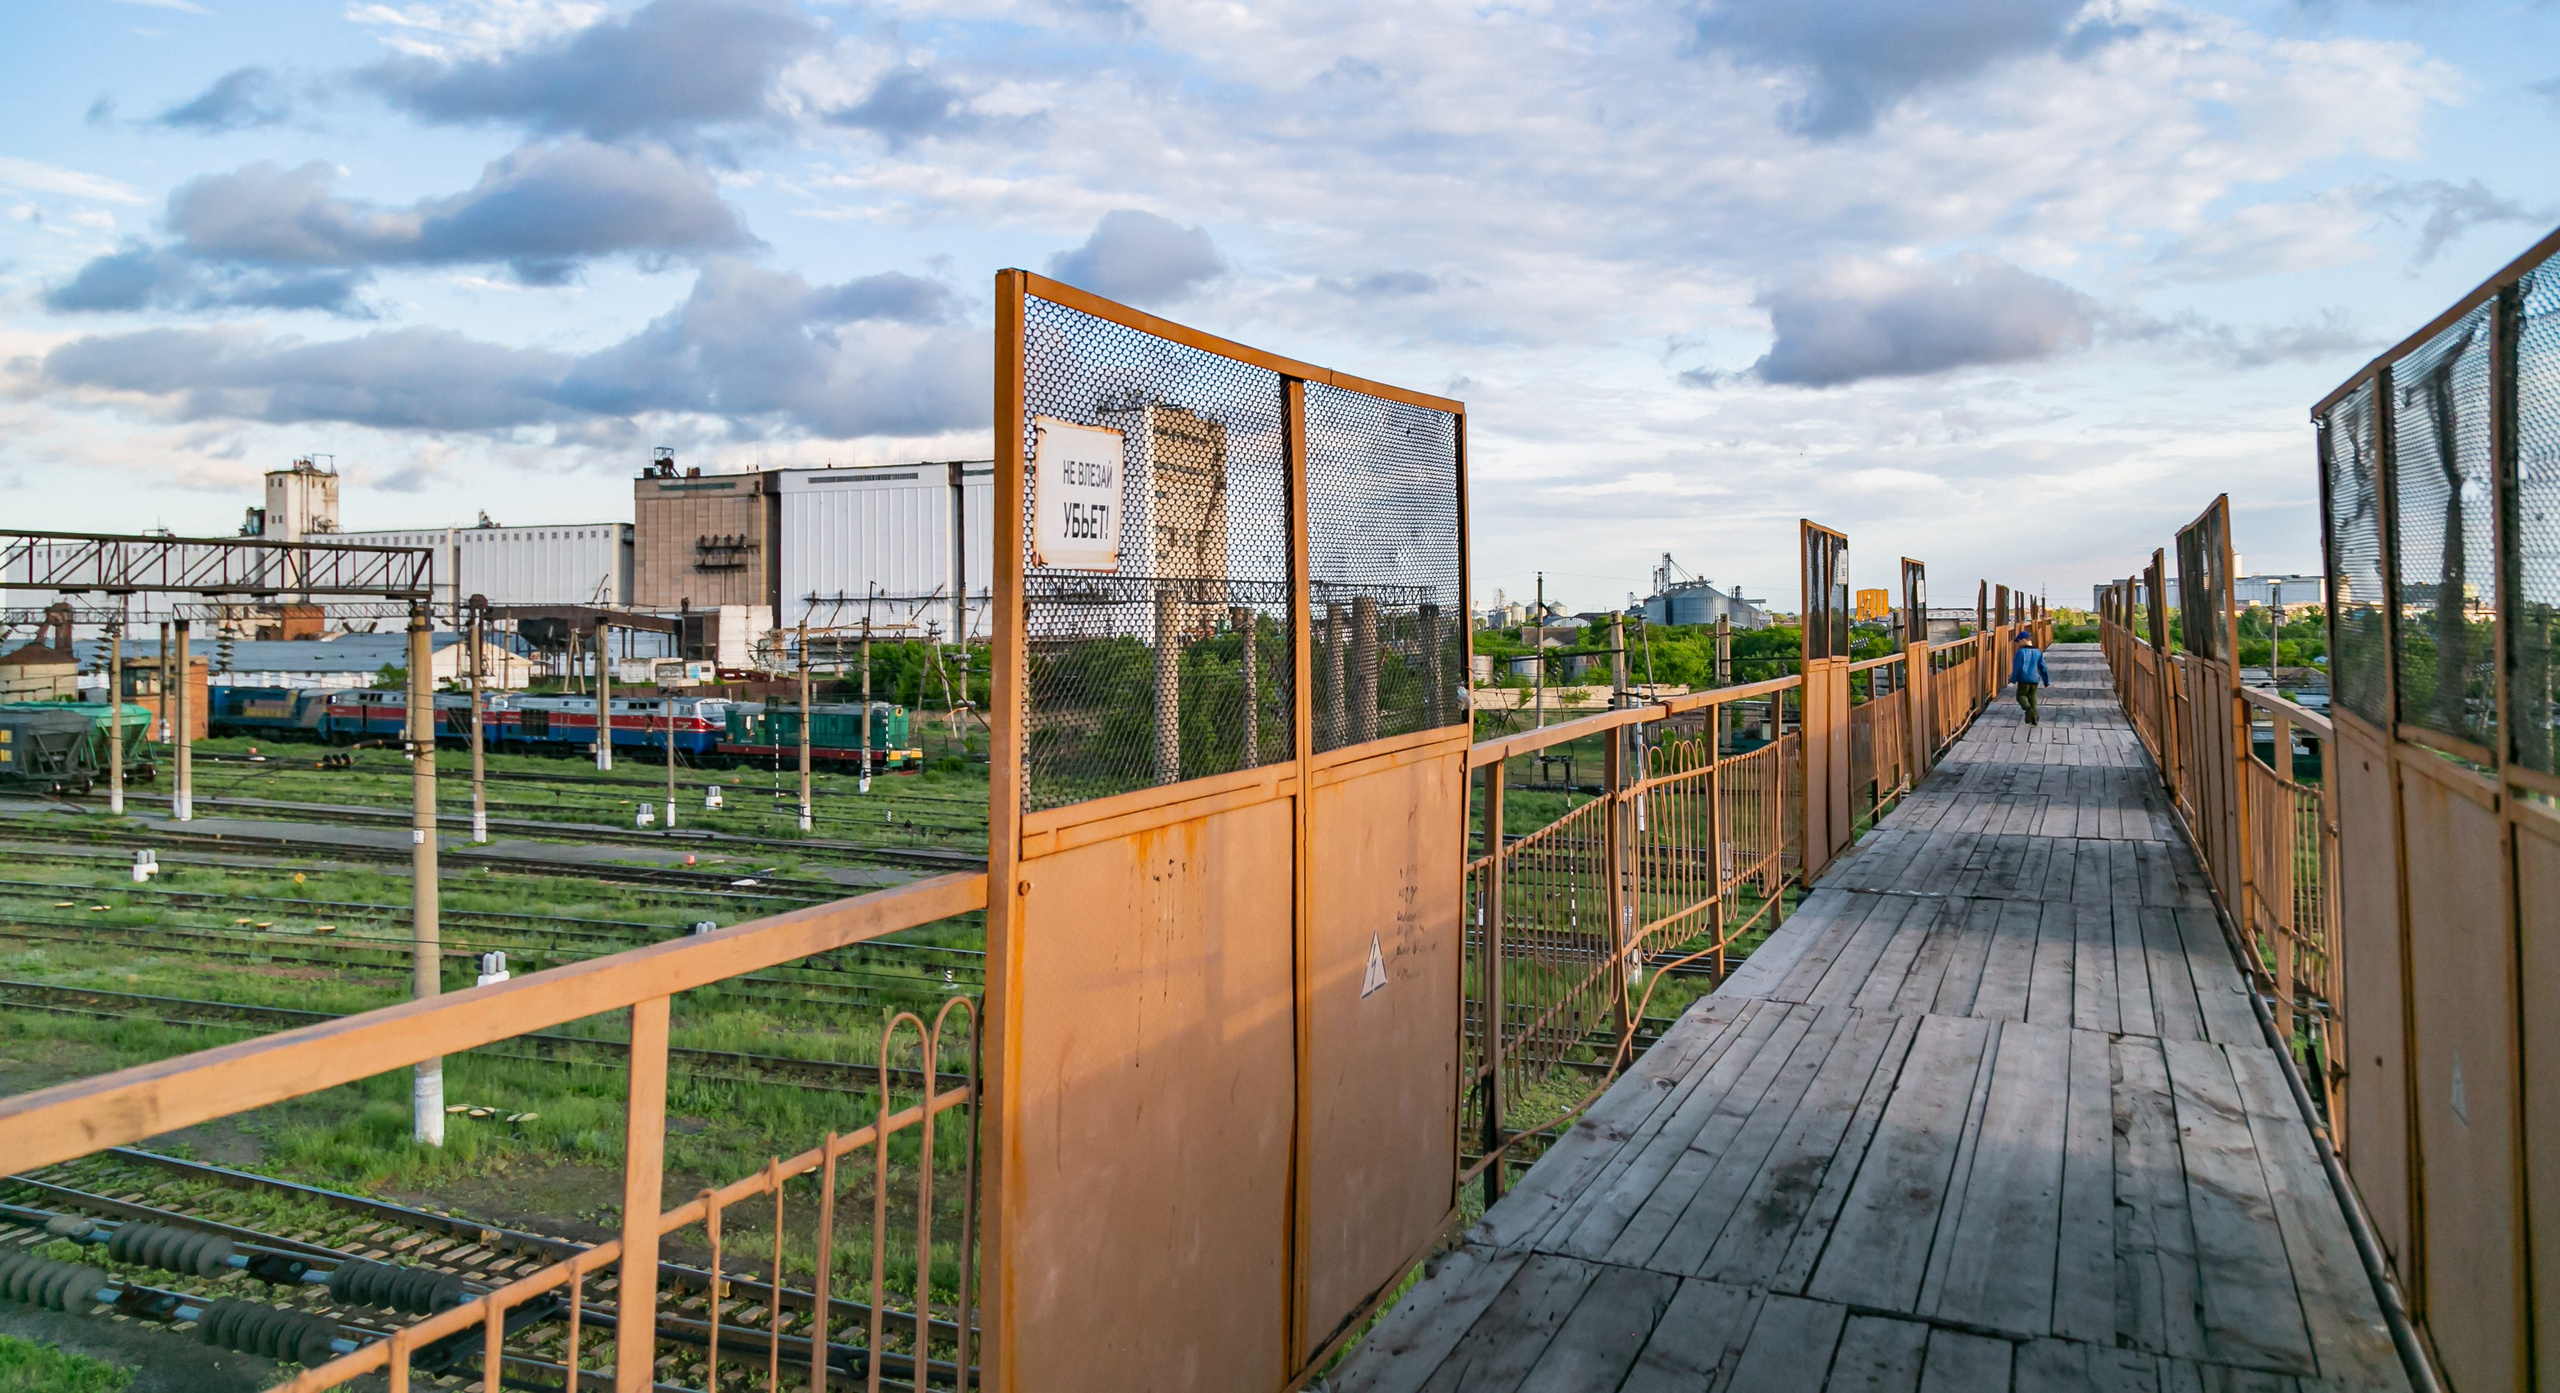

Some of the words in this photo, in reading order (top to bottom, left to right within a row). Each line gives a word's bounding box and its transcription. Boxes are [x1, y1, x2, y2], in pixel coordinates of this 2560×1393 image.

[1063, 460, 1076, 485] НЕ
[1078, 460, 1113, 489] ВЛЕЗАЙ
[1063, 502, 1109, 540] УБЬЕТ!
